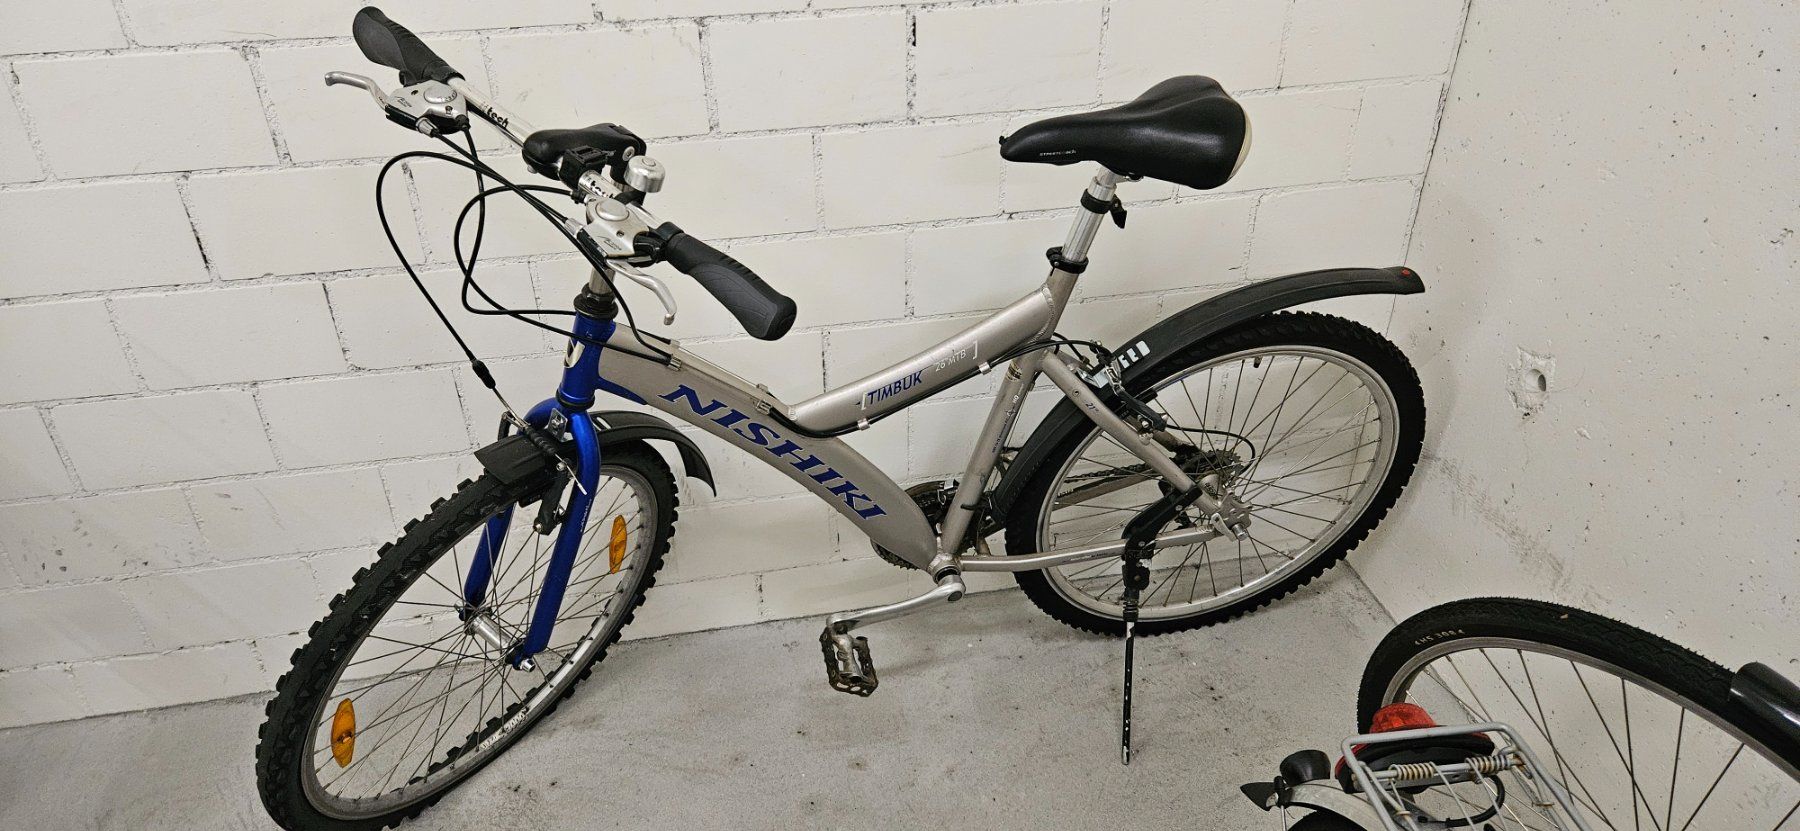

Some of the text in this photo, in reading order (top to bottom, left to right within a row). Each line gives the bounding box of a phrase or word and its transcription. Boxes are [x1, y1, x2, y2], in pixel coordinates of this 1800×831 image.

[867, 369, 923, 404] TIMBUK
[948, 349, 967, 365] MTB
[657, 384, 887, 520] NISHIKI
